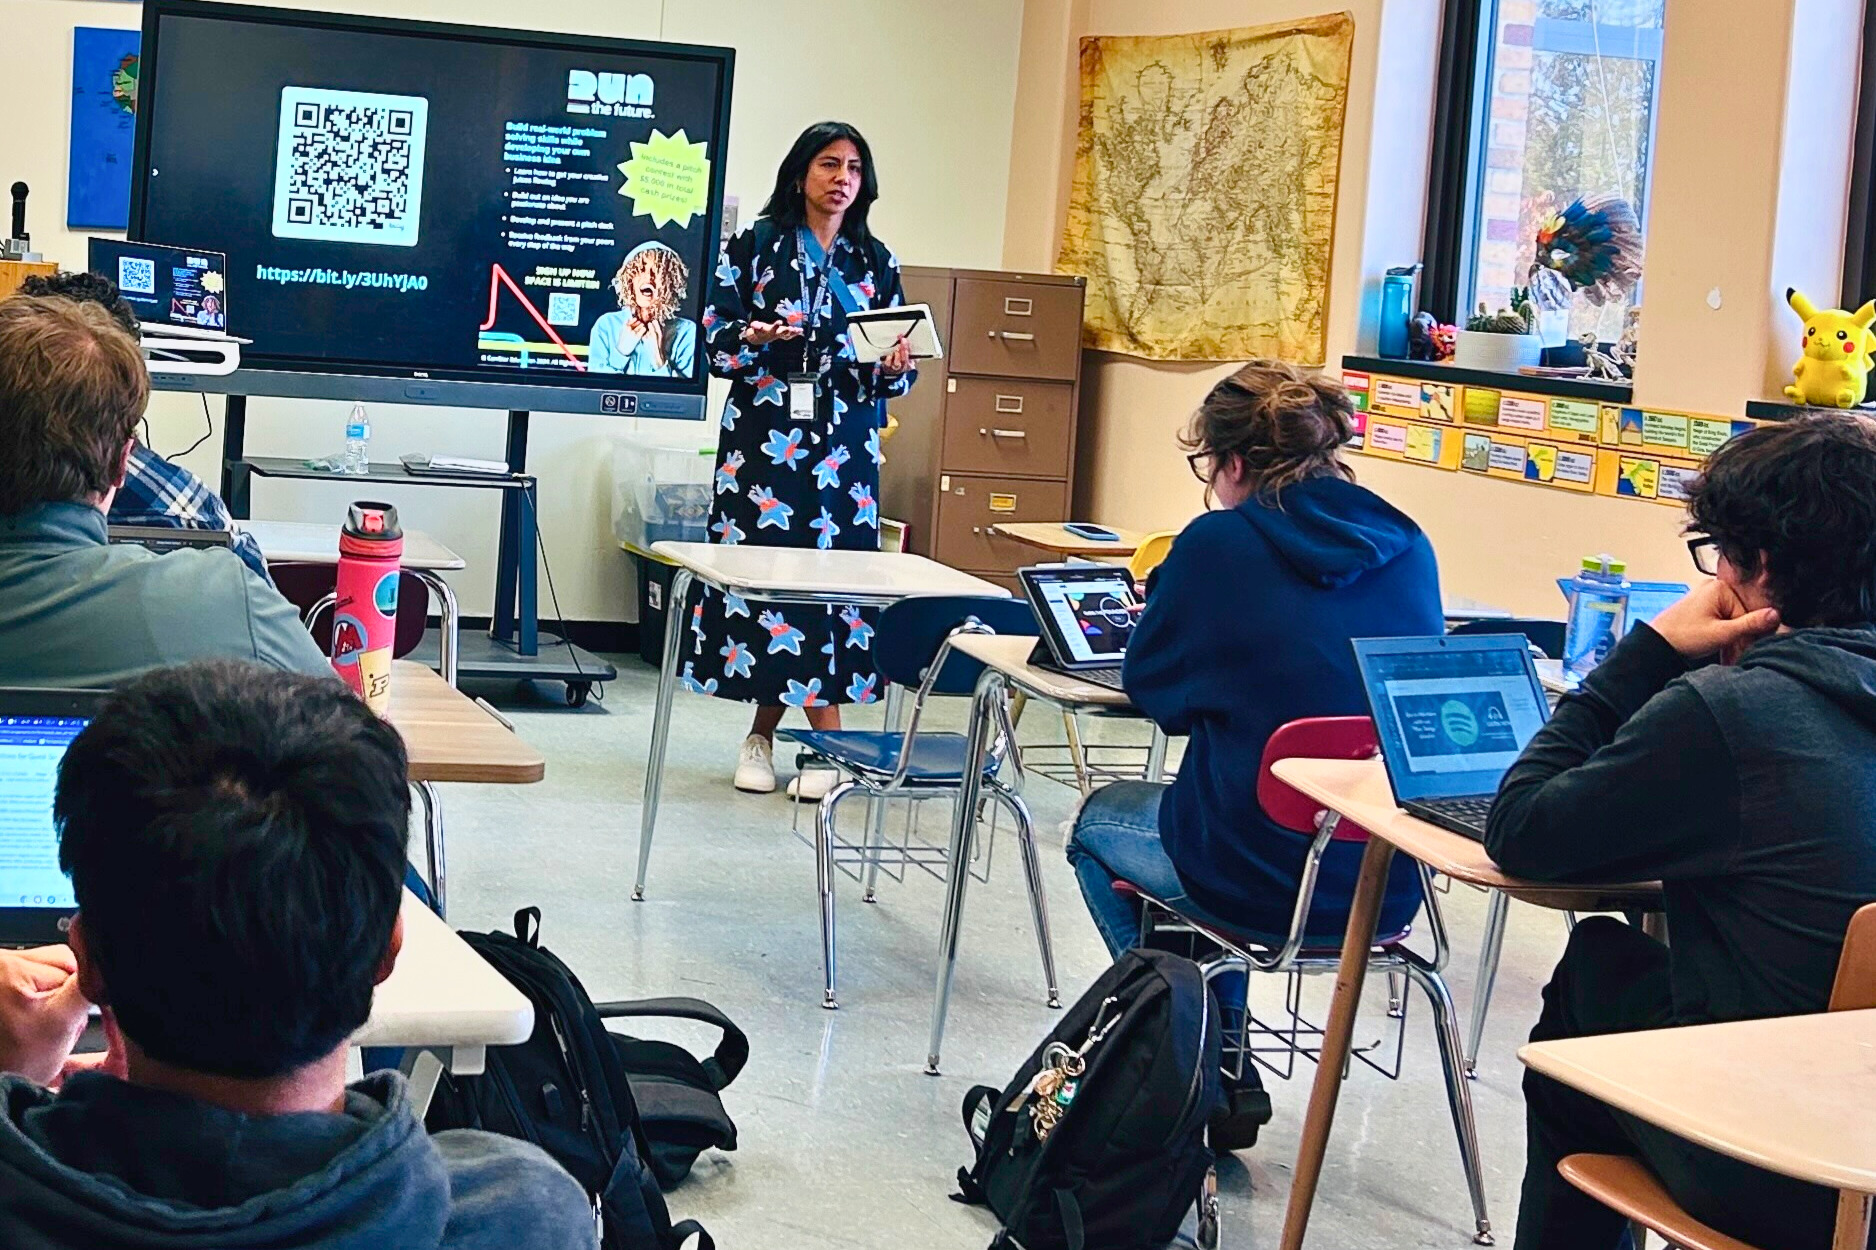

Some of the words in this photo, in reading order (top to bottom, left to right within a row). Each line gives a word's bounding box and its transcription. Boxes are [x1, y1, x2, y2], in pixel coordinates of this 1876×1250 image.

[591, 101, 612, 115] the
[614, 103, 655, 119] future.
[506, 122, 528, 131] Build
[505, 133, 536, 144] solving
[552, 147, 571, 155] your
[682, 165, 702, 173] pitch
[646, 167, 674, 178] contest
[676, 174, 693, 182] with
[640, 188, 659, 196] cash
[676, 185, 693, 194] total
[558, 268, 571, 277] UP
